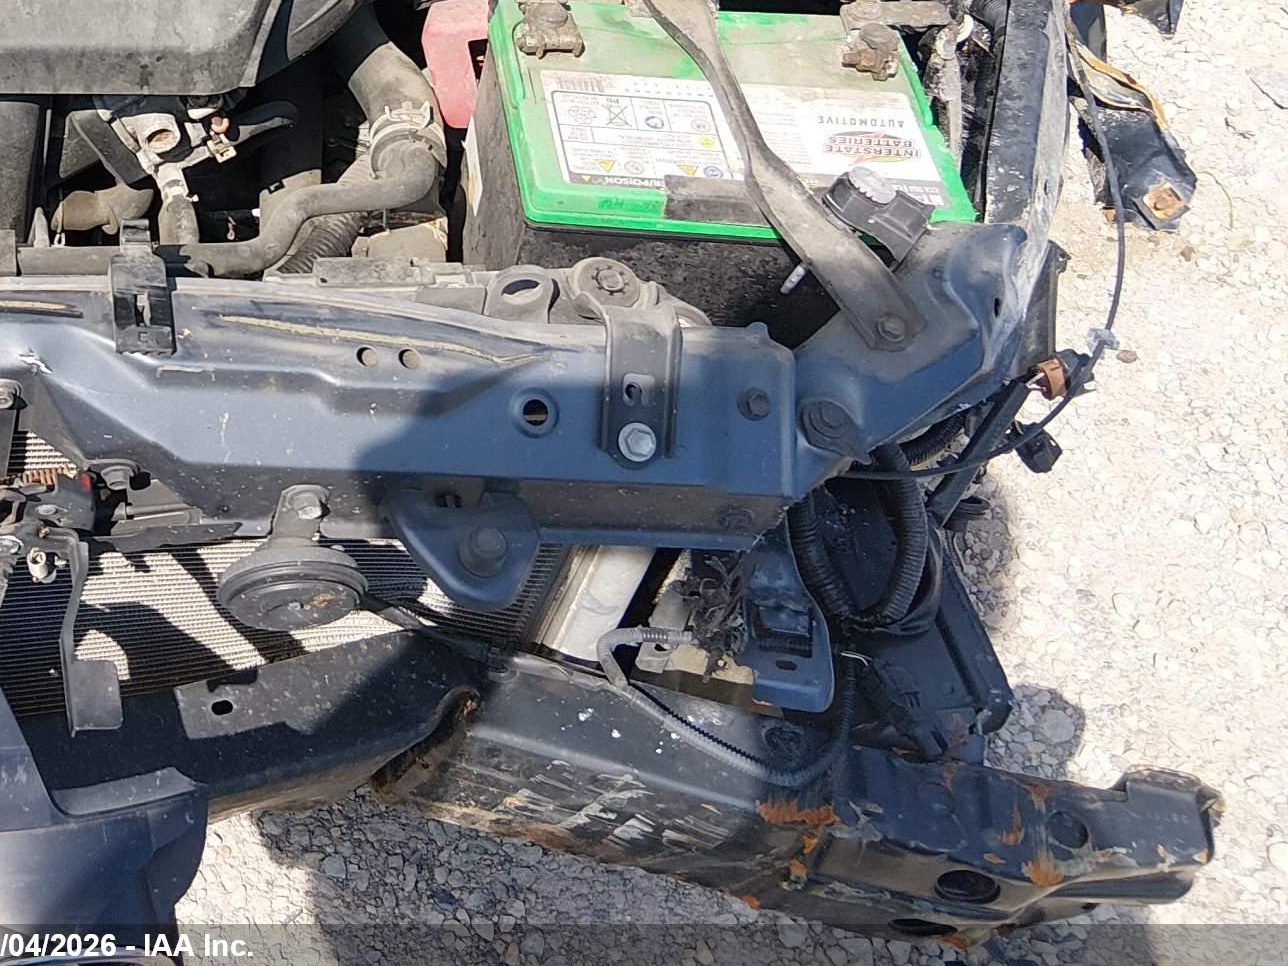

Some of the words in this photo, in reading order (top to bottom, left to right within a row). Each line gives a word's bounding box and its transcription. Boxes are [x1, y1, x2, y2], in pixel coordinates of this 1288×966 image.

[817, 115, 904, 129] AUTOMOTIVE
[828, 136, 913, 148] BATTERIES
[824, 144, 919, 158] INTERSTATE
